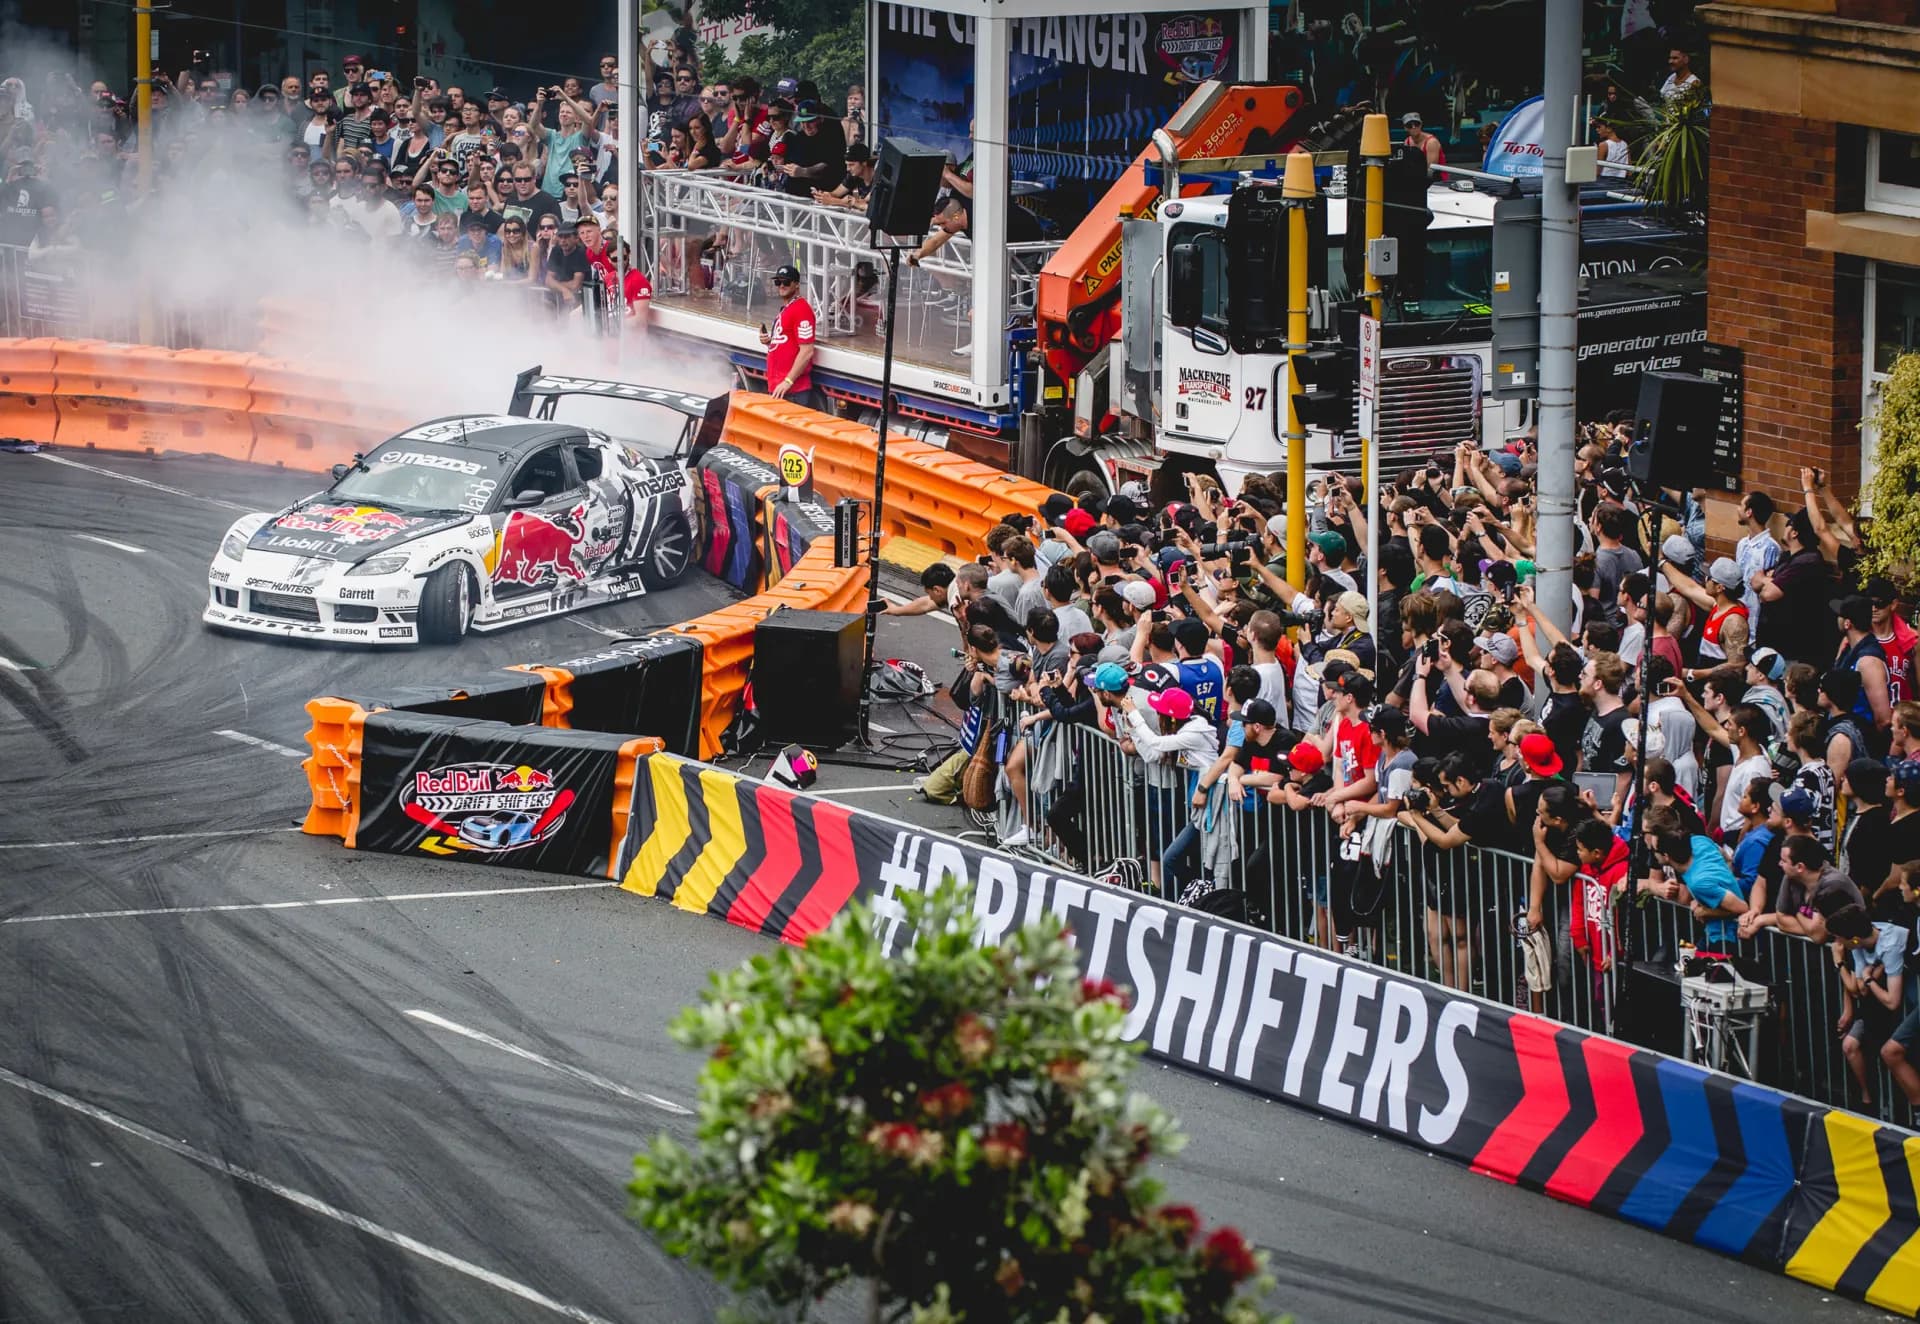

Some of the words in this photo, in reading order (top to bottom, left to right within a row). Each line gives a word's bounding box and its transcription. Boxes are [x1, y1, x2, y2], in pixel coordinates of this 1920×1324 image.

[1203, 112, 1238, 150] 36002
[1383, 251, 1391, 263] 3
[1577, 335, 1661, 362] generator
[1612, 355, 1683, 376] services
[1178, 366, 1231, 391] MACKENZIE
[1182, 381, 1214, 393] TRANSPORT
[532, 375, 710, 410] NITTO
[1244, 386, 1267, 411] 27
[782, 457, 803, 474] 225
[339, 586, 375, 601] Garrett
[609, 584, 630, 596] Mobil
[229, 614, 327, 633] NITTO
[380, 627, 402, 637] Mobil
[453, 794, 494, 811] DRIFT
[496, 792, 554, 809] SHIFTERS
